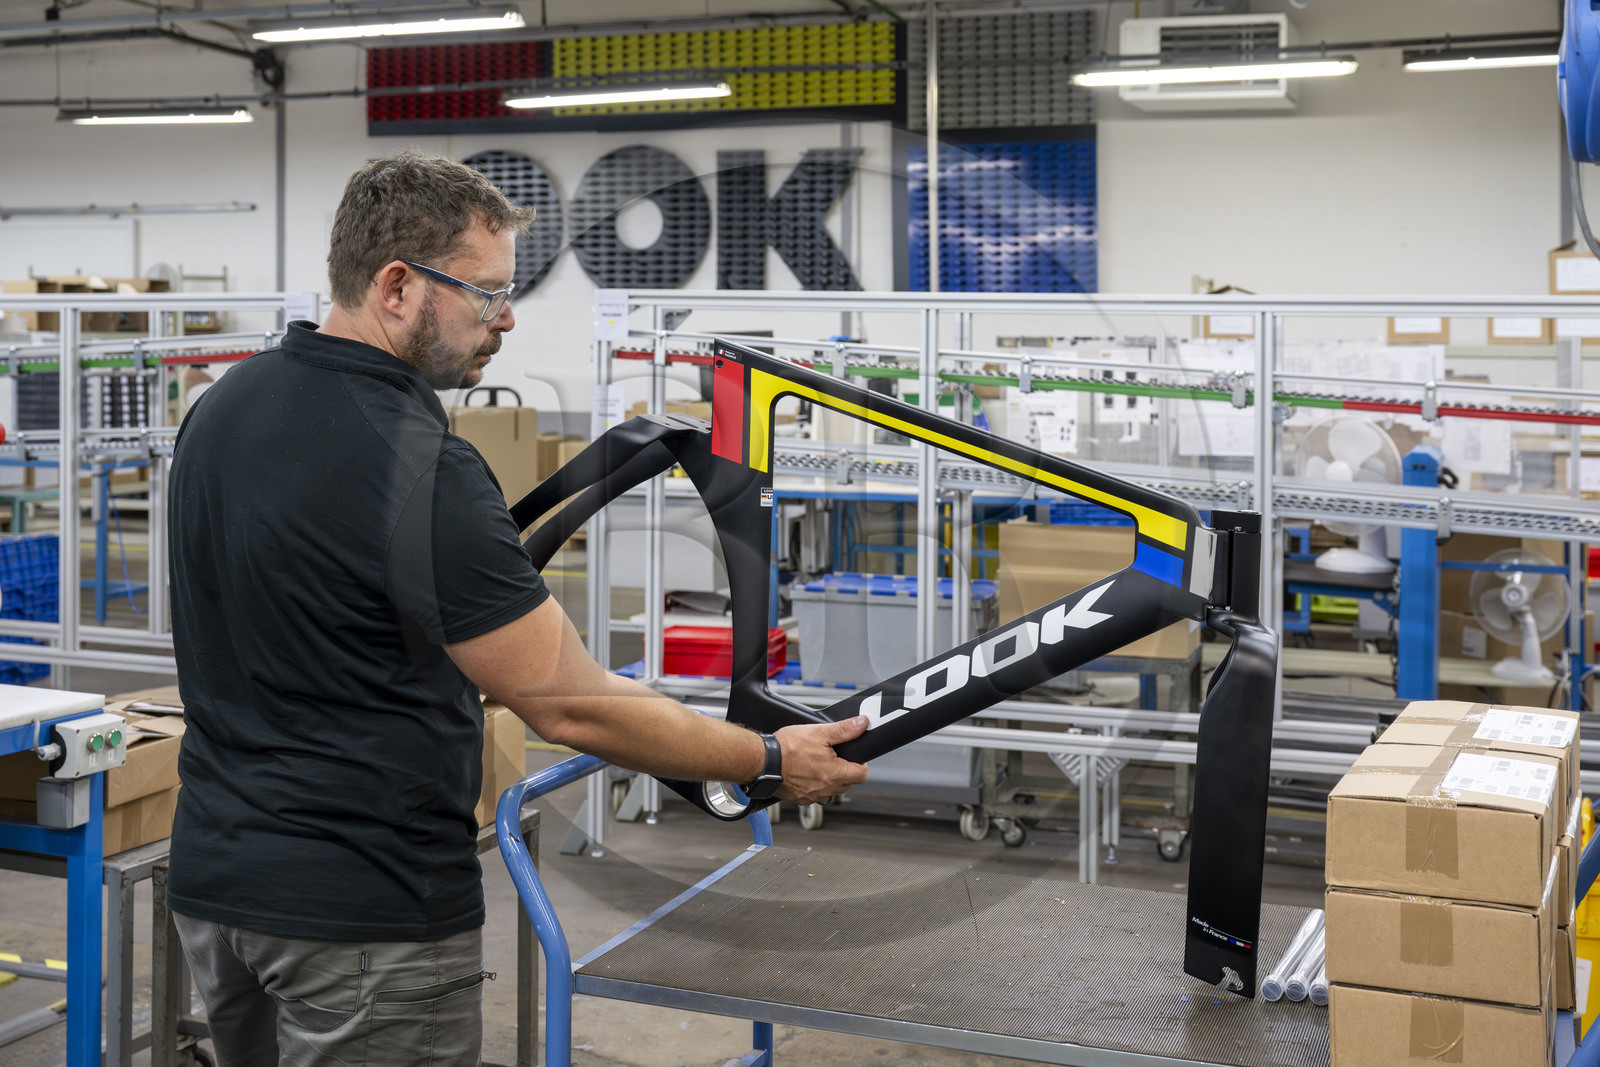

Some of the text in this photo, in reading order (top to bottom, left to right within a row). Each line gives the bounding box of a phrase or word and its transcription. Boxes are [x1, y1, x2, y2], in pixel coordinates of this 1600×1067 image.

[859, 579, 1116, 731] LOOK
[1191, 916, 1210, 928] Made
[1208, 929, 1228, 941] France
